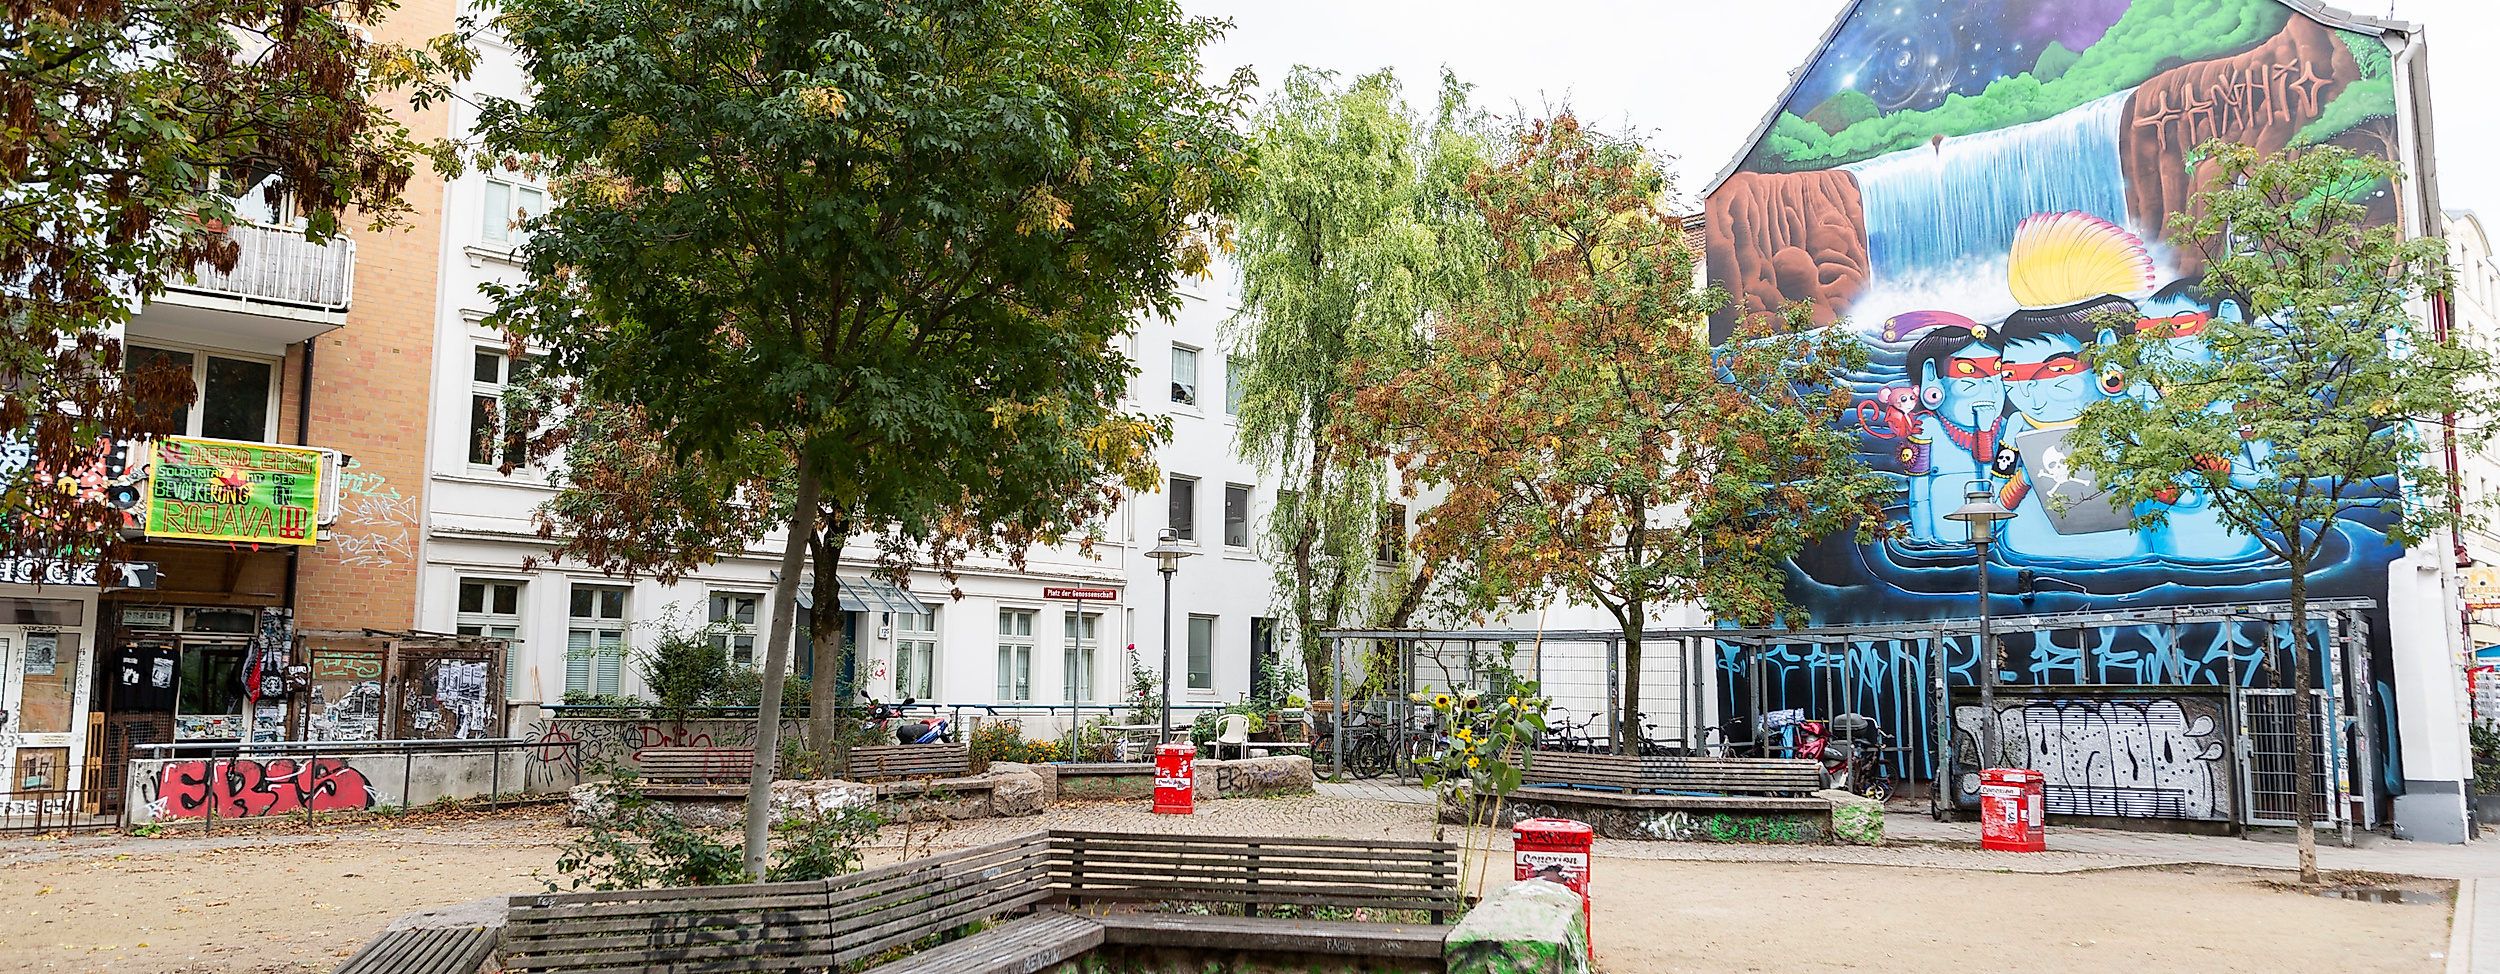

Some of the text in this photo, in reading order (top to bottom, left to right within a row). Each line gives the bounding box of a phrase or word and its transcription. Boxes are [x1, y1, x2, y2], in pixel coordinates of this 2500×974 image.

[246, 473, 265, 483] MIT
[273, 474, 295, 486] DER
[154, 478, 293, 505] BEVÖLKERUNG IN
[1047, 589, 1061, 597] Platz
[1072, 590, 1114, 599] Genossenschaft
